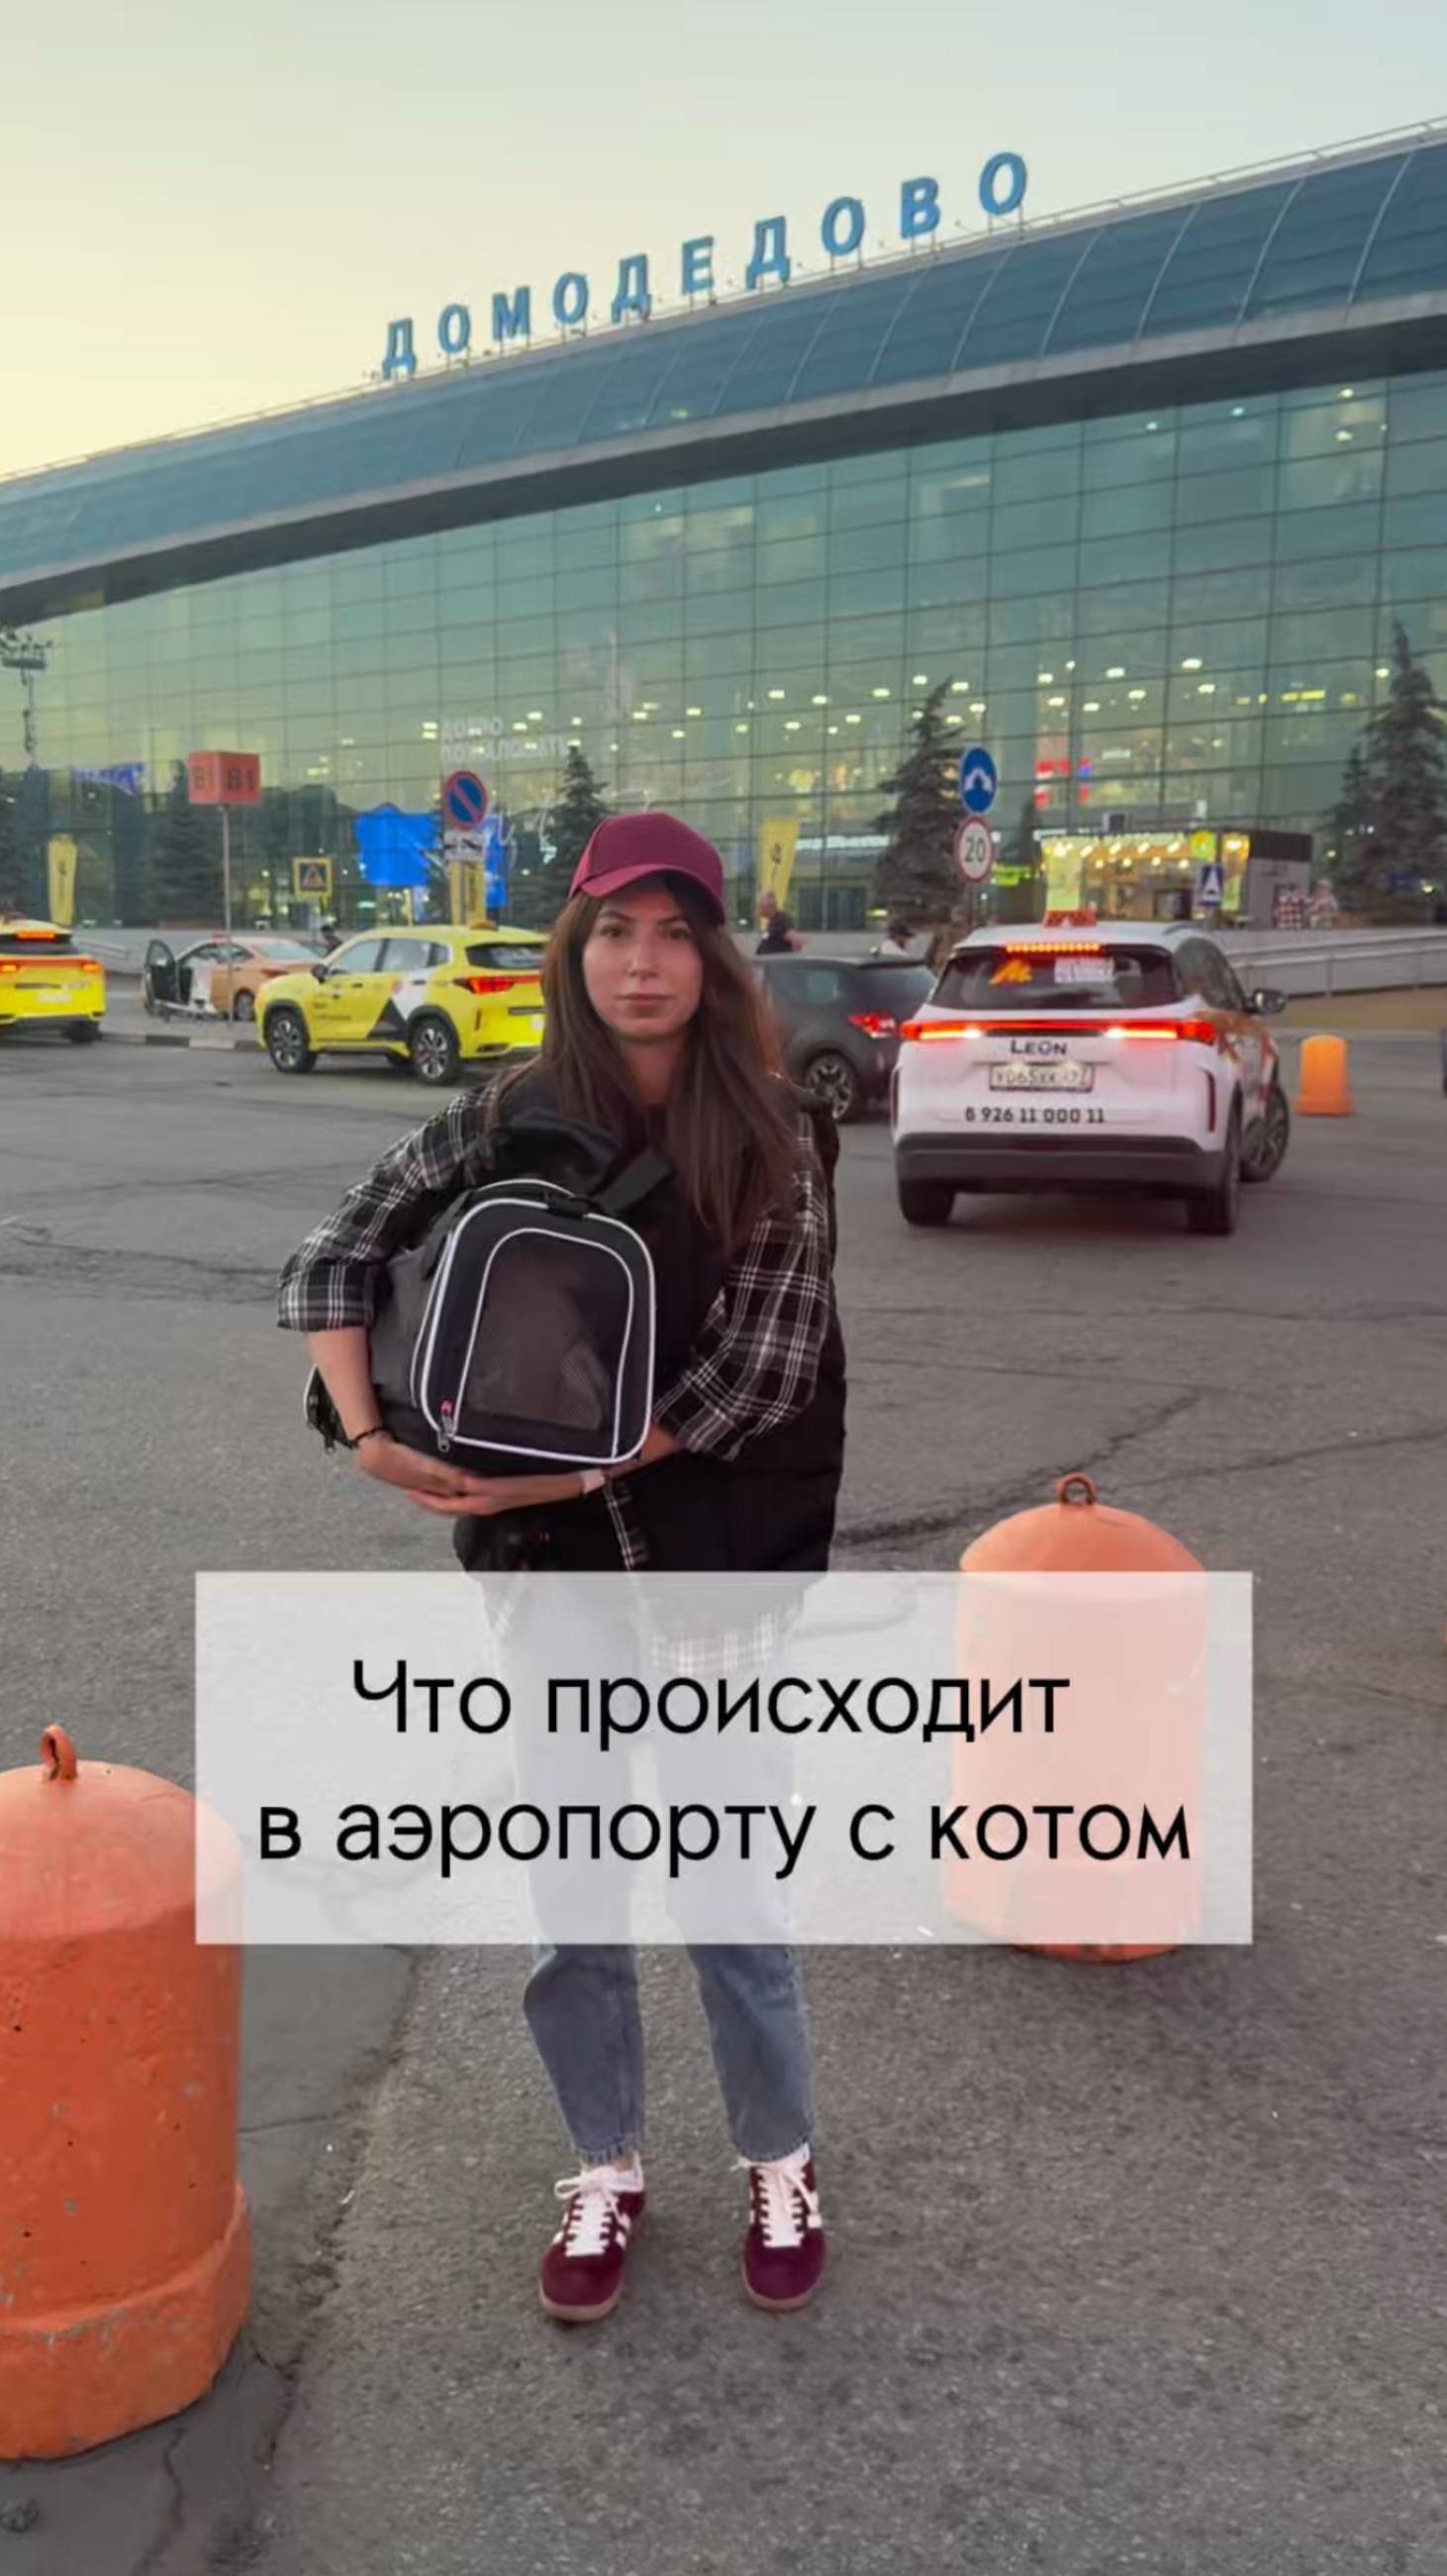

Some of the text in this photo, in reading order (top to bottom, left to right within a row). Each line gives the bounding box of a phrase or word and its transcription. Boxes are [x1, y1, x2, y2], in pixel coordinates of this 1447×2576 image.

[382, 151, 1028, 380] ДОМОДЕДОВО
[964, 837, 987, 863] 20
[1010, 1040, 1068, 1055] LEON
[965, 1106, 1106, 1124] 8 926 11 000 11
